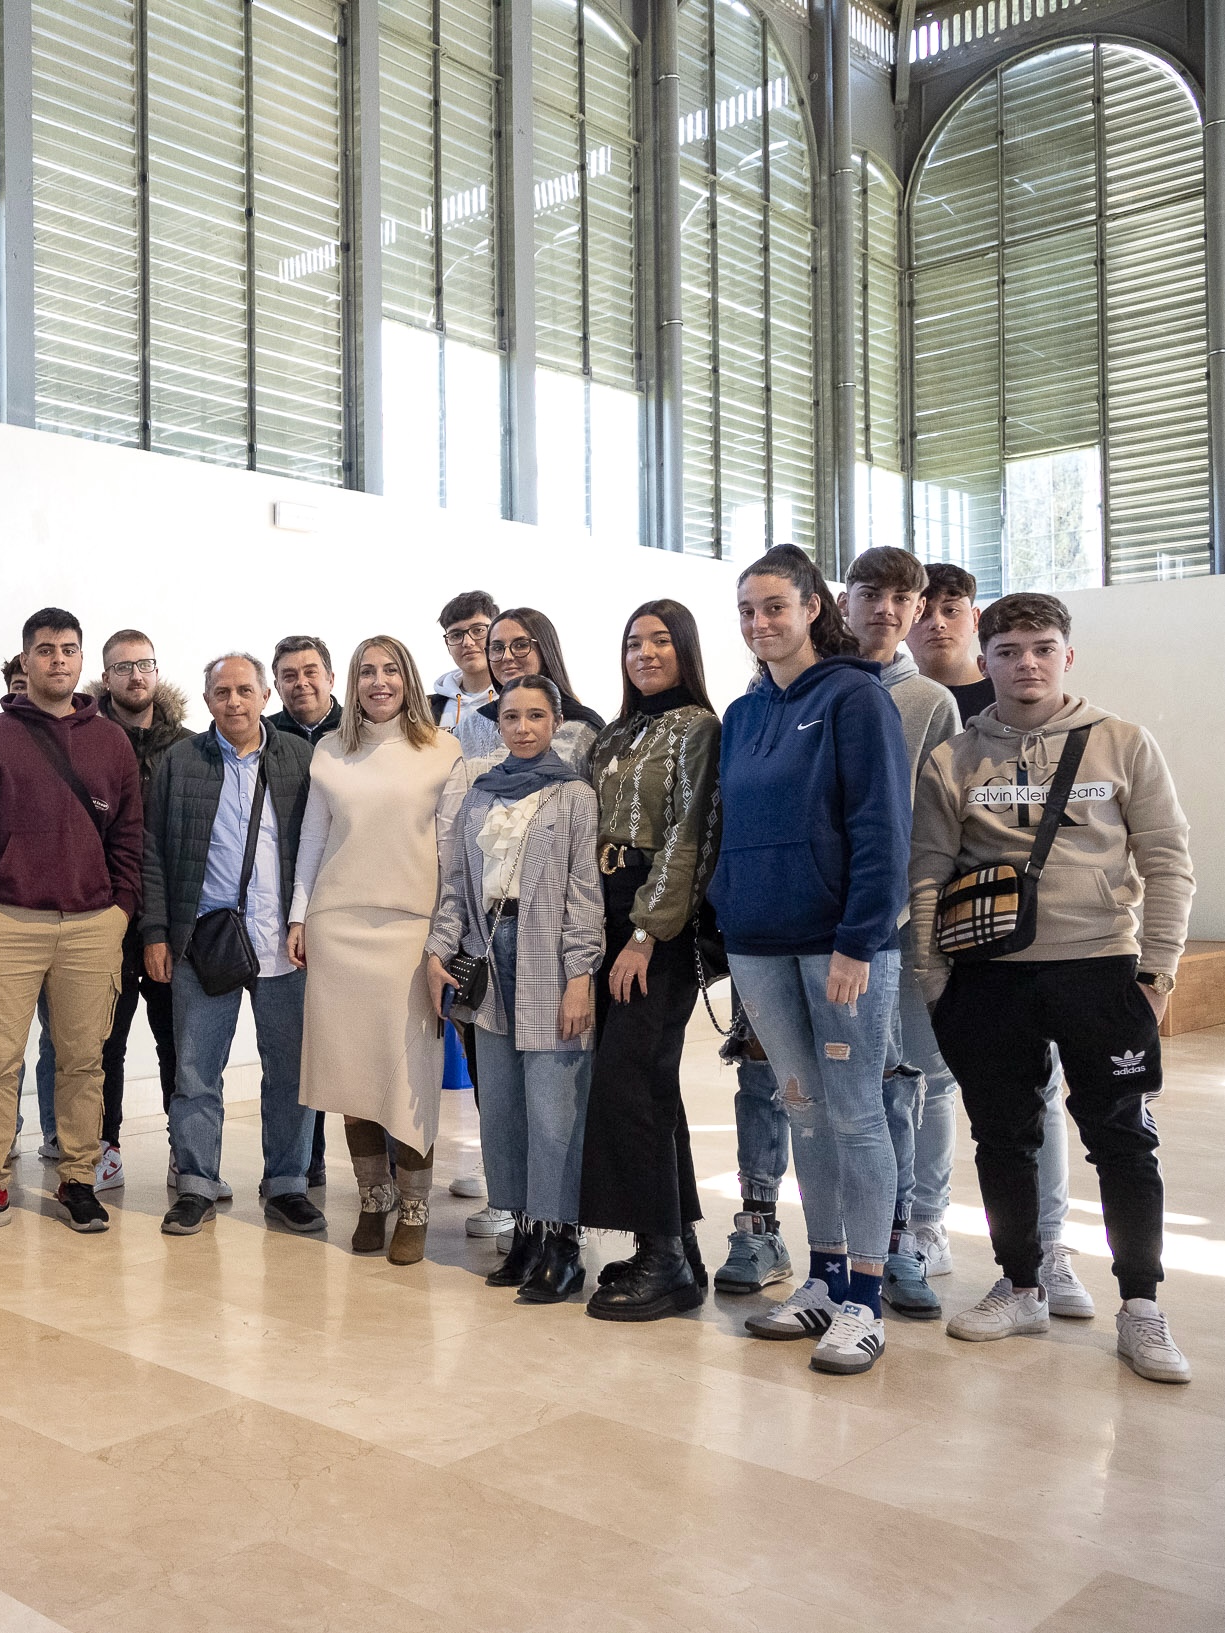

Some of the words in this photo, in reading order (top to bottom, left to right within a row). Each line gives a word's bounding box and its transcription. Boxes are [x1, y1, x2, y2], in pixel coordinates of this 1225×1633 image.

[967, 787, 1012, 804] Calvin
[1015, 786, 1051, 802] Klei
[1068, 786, 1106, 799] eans
[1112, 1065, 1146, 1076] adidas
